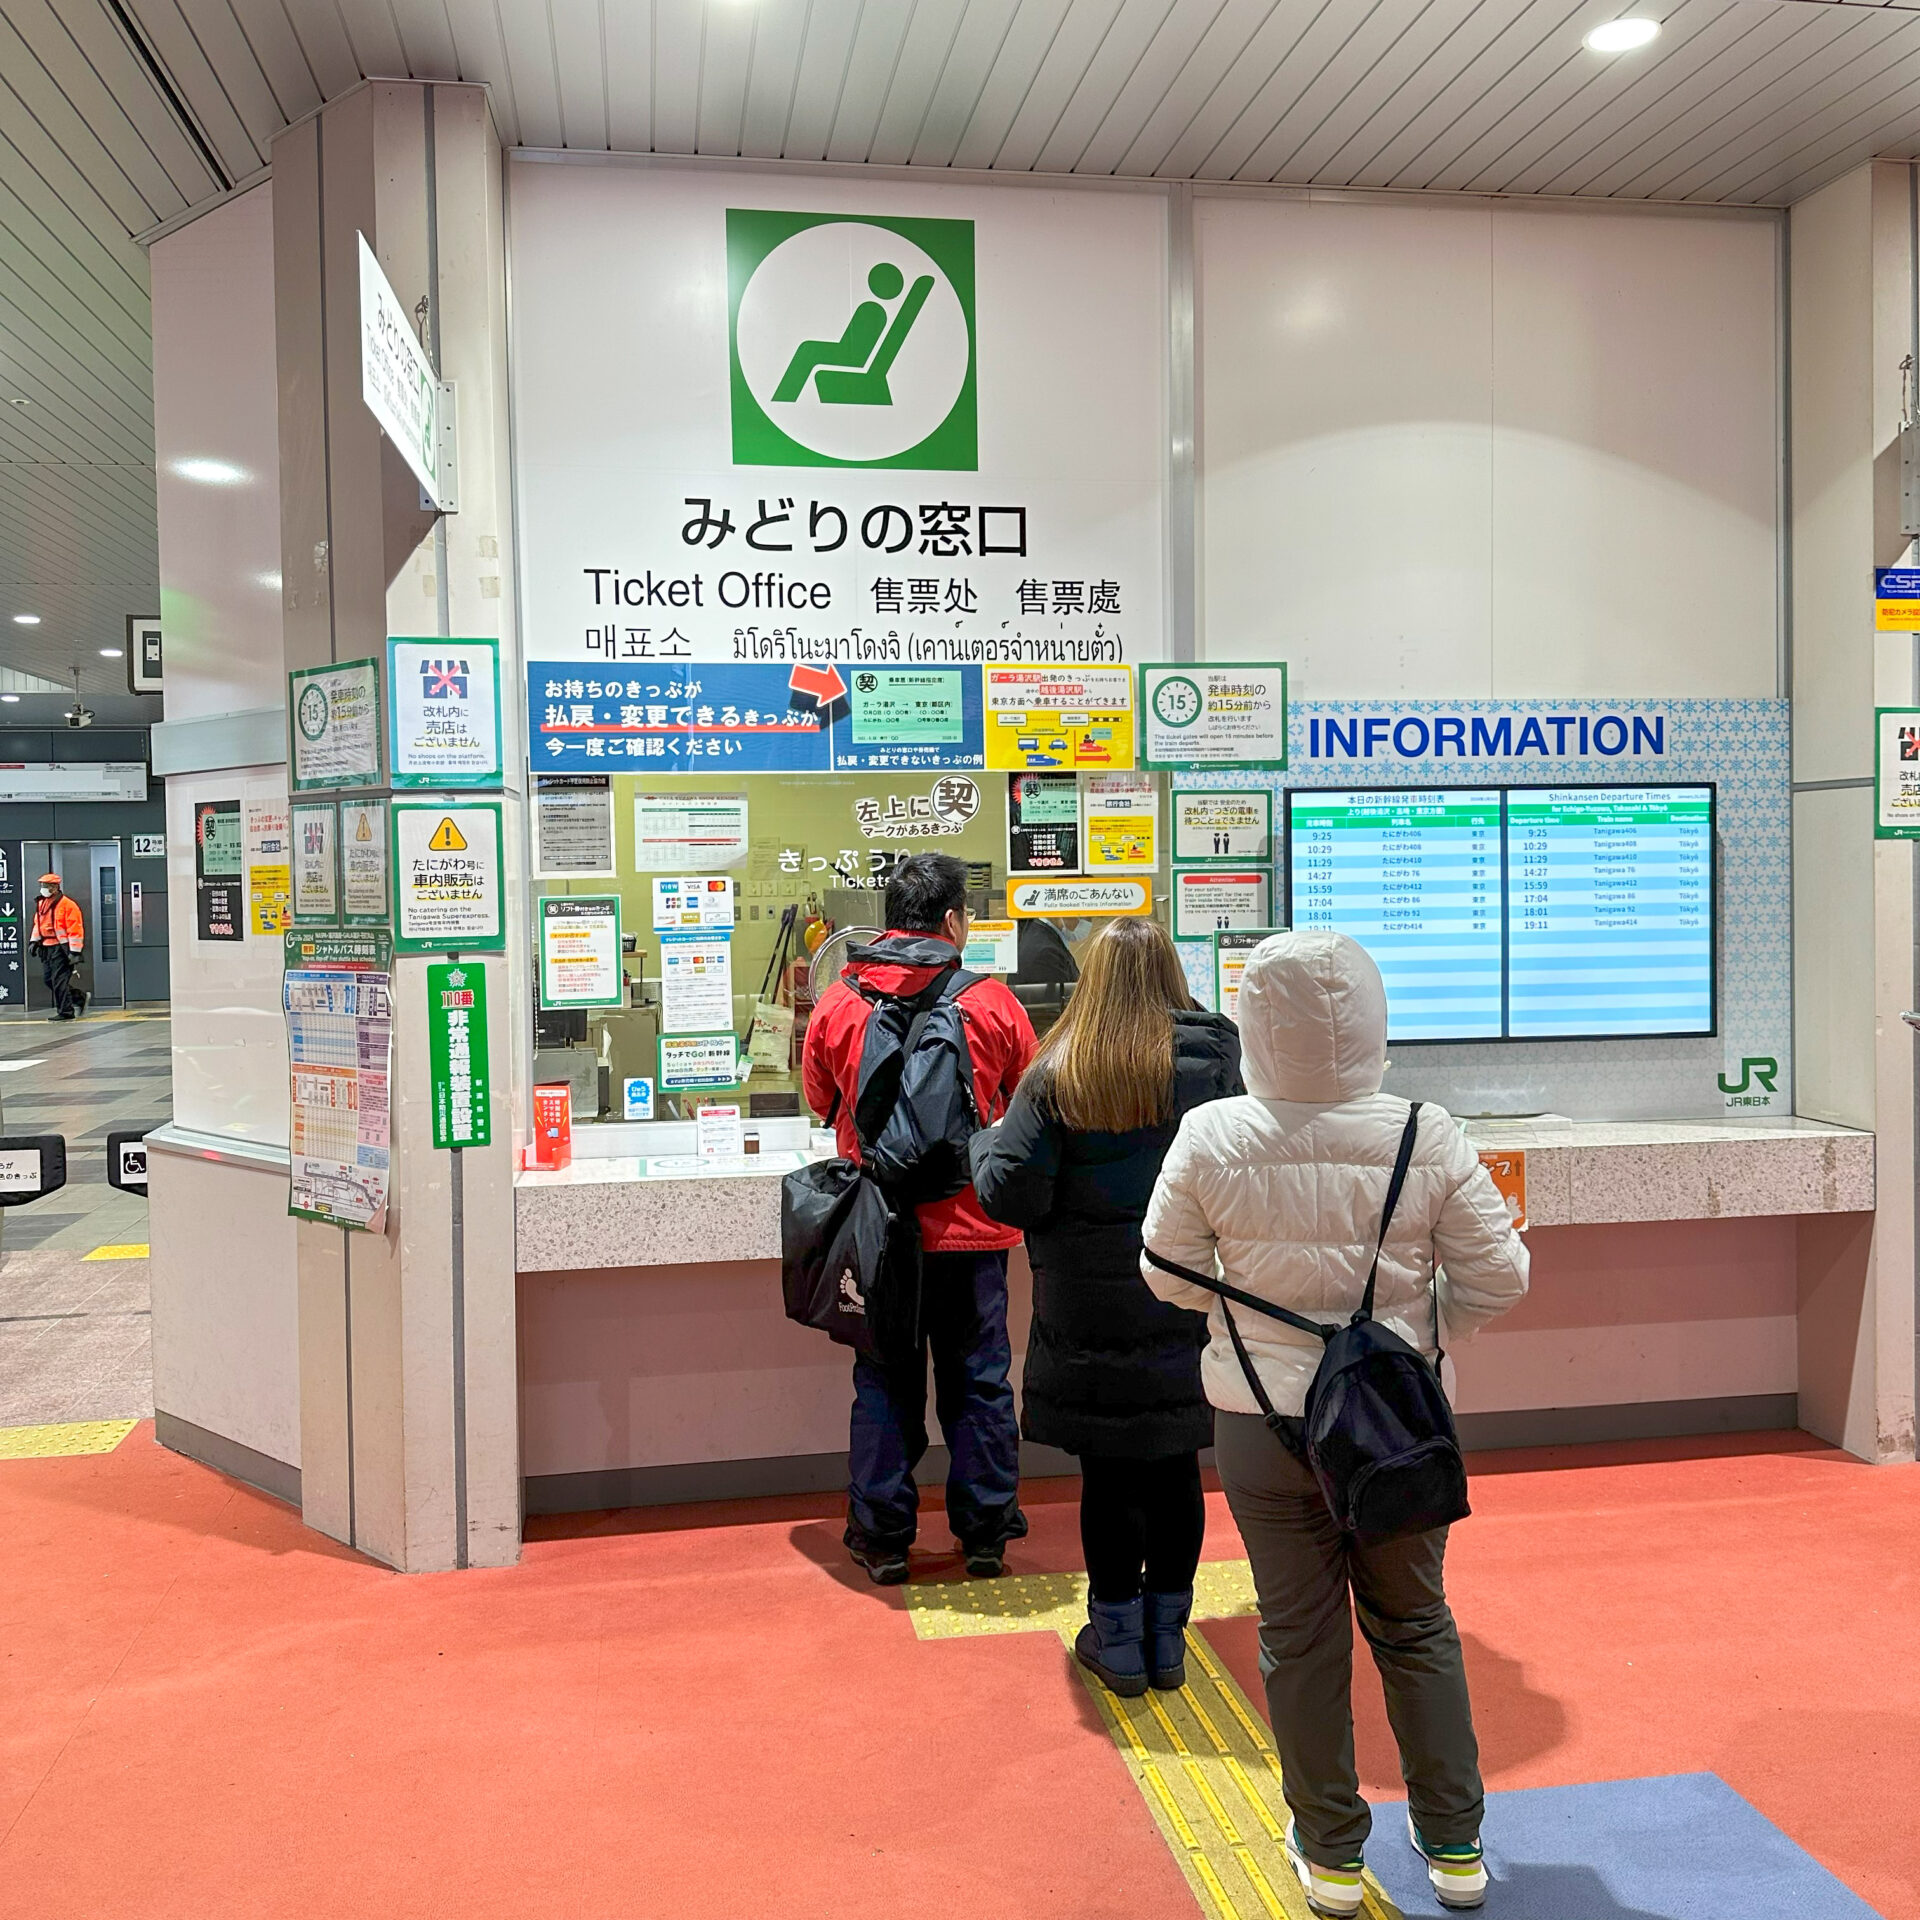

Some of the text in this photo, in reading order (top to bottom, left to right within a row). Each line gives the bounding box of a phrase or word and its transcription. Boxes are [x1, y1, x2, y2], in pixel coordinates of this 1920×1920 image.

[682, 497, 1026, 557] みどりの窓口
[584, 569, 831, 609] Ticket Office
[870, 577, 1122, 615] 售票处 售票處
[586, 624, 691, 660] 매표소
[545, 680, 702, 699] お持ちのきっぷが
[1208, 684, 1266, 696] 発車時刻の
[992, 697, 1126, 706] 東京方面へ乗車することができます
[1168, 695, 1186, 710] 15
[1208, 699, 1271, 711] 約15分前から
[307, 703, 318, 721] 15
[424, 706, 469, 717] 改札内に
[545, 704, 818, 728] 払戻・変更できるきっぷか
[426, 720, 467, 734] 売店は
[414, 737, 480, 747] ございません
[1310, 715, 1664, 758] INFORMATION
[545, 737, 743, 757] 今一度ご確認ください
[837, 755, 983, 766] 払戻・変更できないきっぷの例
[1900, 771, 1920, 780] 改札
[1347, 794, 1445, 804] 本日の新幹線発車時刻表
[1549, 793, 1599, 801] Shinkansen
[1601, 793, 1643, 802] Departure
[1645, 792, 1671, 800] Times
[1184, 807, 1259, 815] 改札内でつぎの電車を
[1184, 817, 1259, 825] 待つことはできません
[1510, 817, 1543, 825] Departure
[1597, 815, 1613, 823] Train
[1670, 814, 1707, 822] Destination
[862, 822, 963, 838] マークがあるきっぷ
[1528, 829, 1547, 837] 9:25
[1312, 832, 1332, 840] 9:25
[135, 838, 151, 853] 12
[1308, 845, 1332, 854] 10:29
[1523, 842, 1547, 850] 10:29
[412, 858, 485, 871] たにがわ号に
[778, 848, 942, 872] きっぷうり
[1308, 859, 1332, 867] 11:29
[413, 873, 484, 887] 車内販売は
[1308, 872, 1332, 880] 14:27
[416, 889, 482, 900] ございません
[1044, 888, 1134, 901] 満席のごあんない
[1308, 885, 1332, 893] 15:59
[1308, 899, 1332, 907] 17:04
[1308, 912, 1332, 920] 18:01
[1523, 908, 1547, 916] 18:01
[1523, 921, 1547, 929] 19:11
[441, 990, 473, 1007] 110番
[1718, 1057, 1778, 1094] JR
[1726, 1096, 1771, 1107] JR東日本
